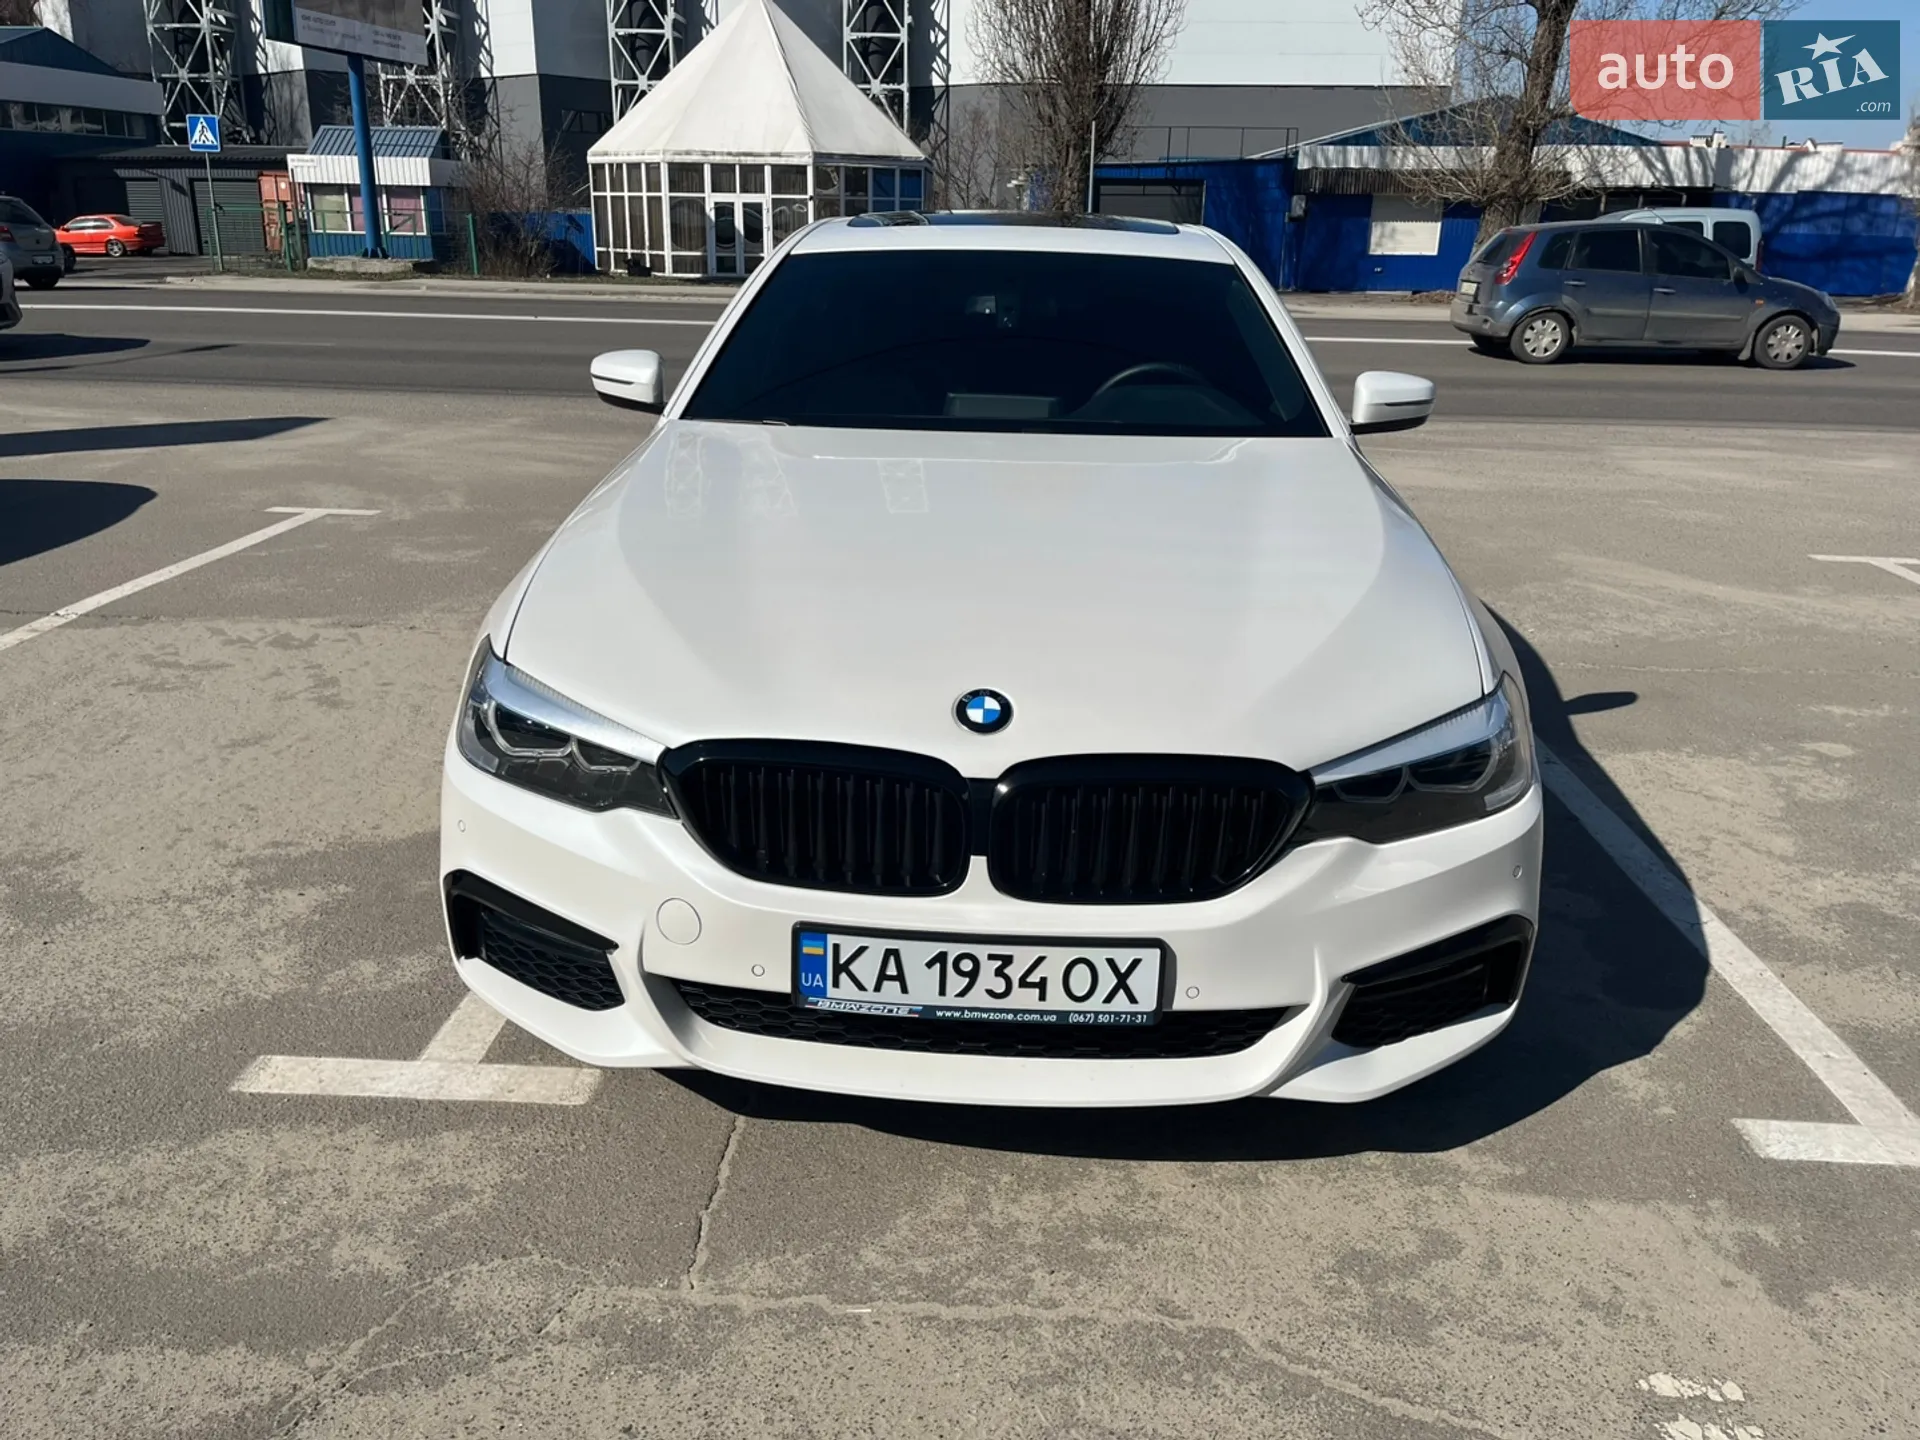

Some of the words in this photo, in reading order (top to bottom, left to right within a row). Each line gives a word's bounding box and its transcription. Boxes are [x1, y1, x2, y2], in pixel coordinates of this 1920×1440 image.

[801, 973, 824, 988] UA
[831, 942, 909, 995] KA
[924, 950, 1048, 1002] 1934
[1061, 956, 1144, 1005] OX
[935, 1008, 1057, 1022] www.bmwzone.com.ua
[1068, 1012, 1094, 1024] (067)
[1097, 1013, 1147, 1024] 501-71-31
